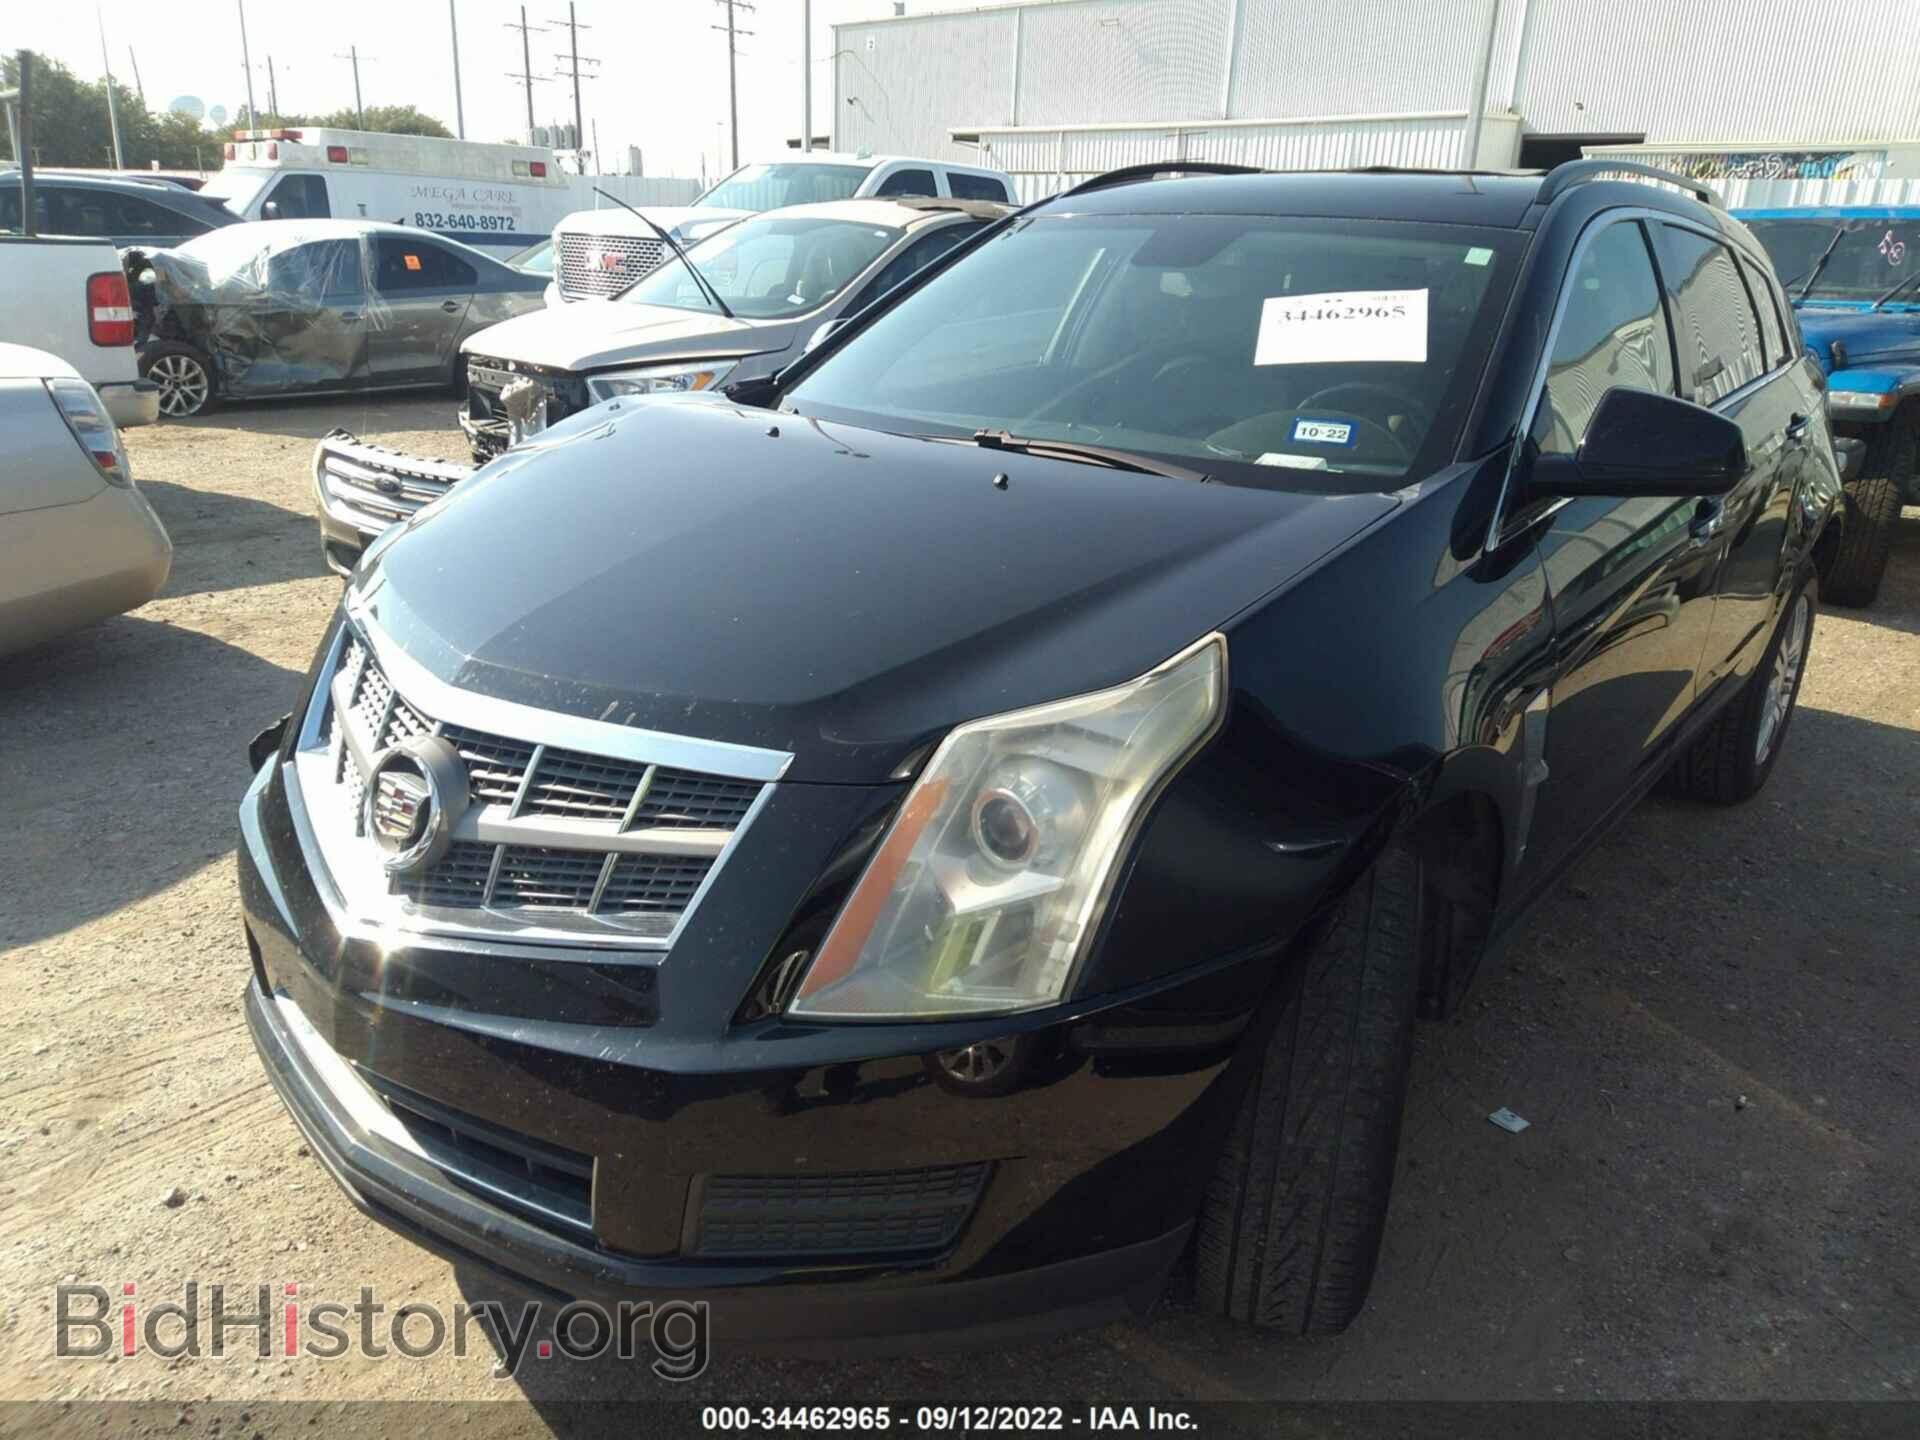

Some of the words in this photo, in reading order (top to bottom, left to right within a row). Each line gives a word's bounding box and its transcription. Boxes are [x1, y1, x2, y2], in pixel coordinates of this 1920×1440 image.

[410, 184, 466, 201] MEGA
[414, 211, 516, 231] 832-640-8972
[1299, 426, 1348, 440] 10-22
